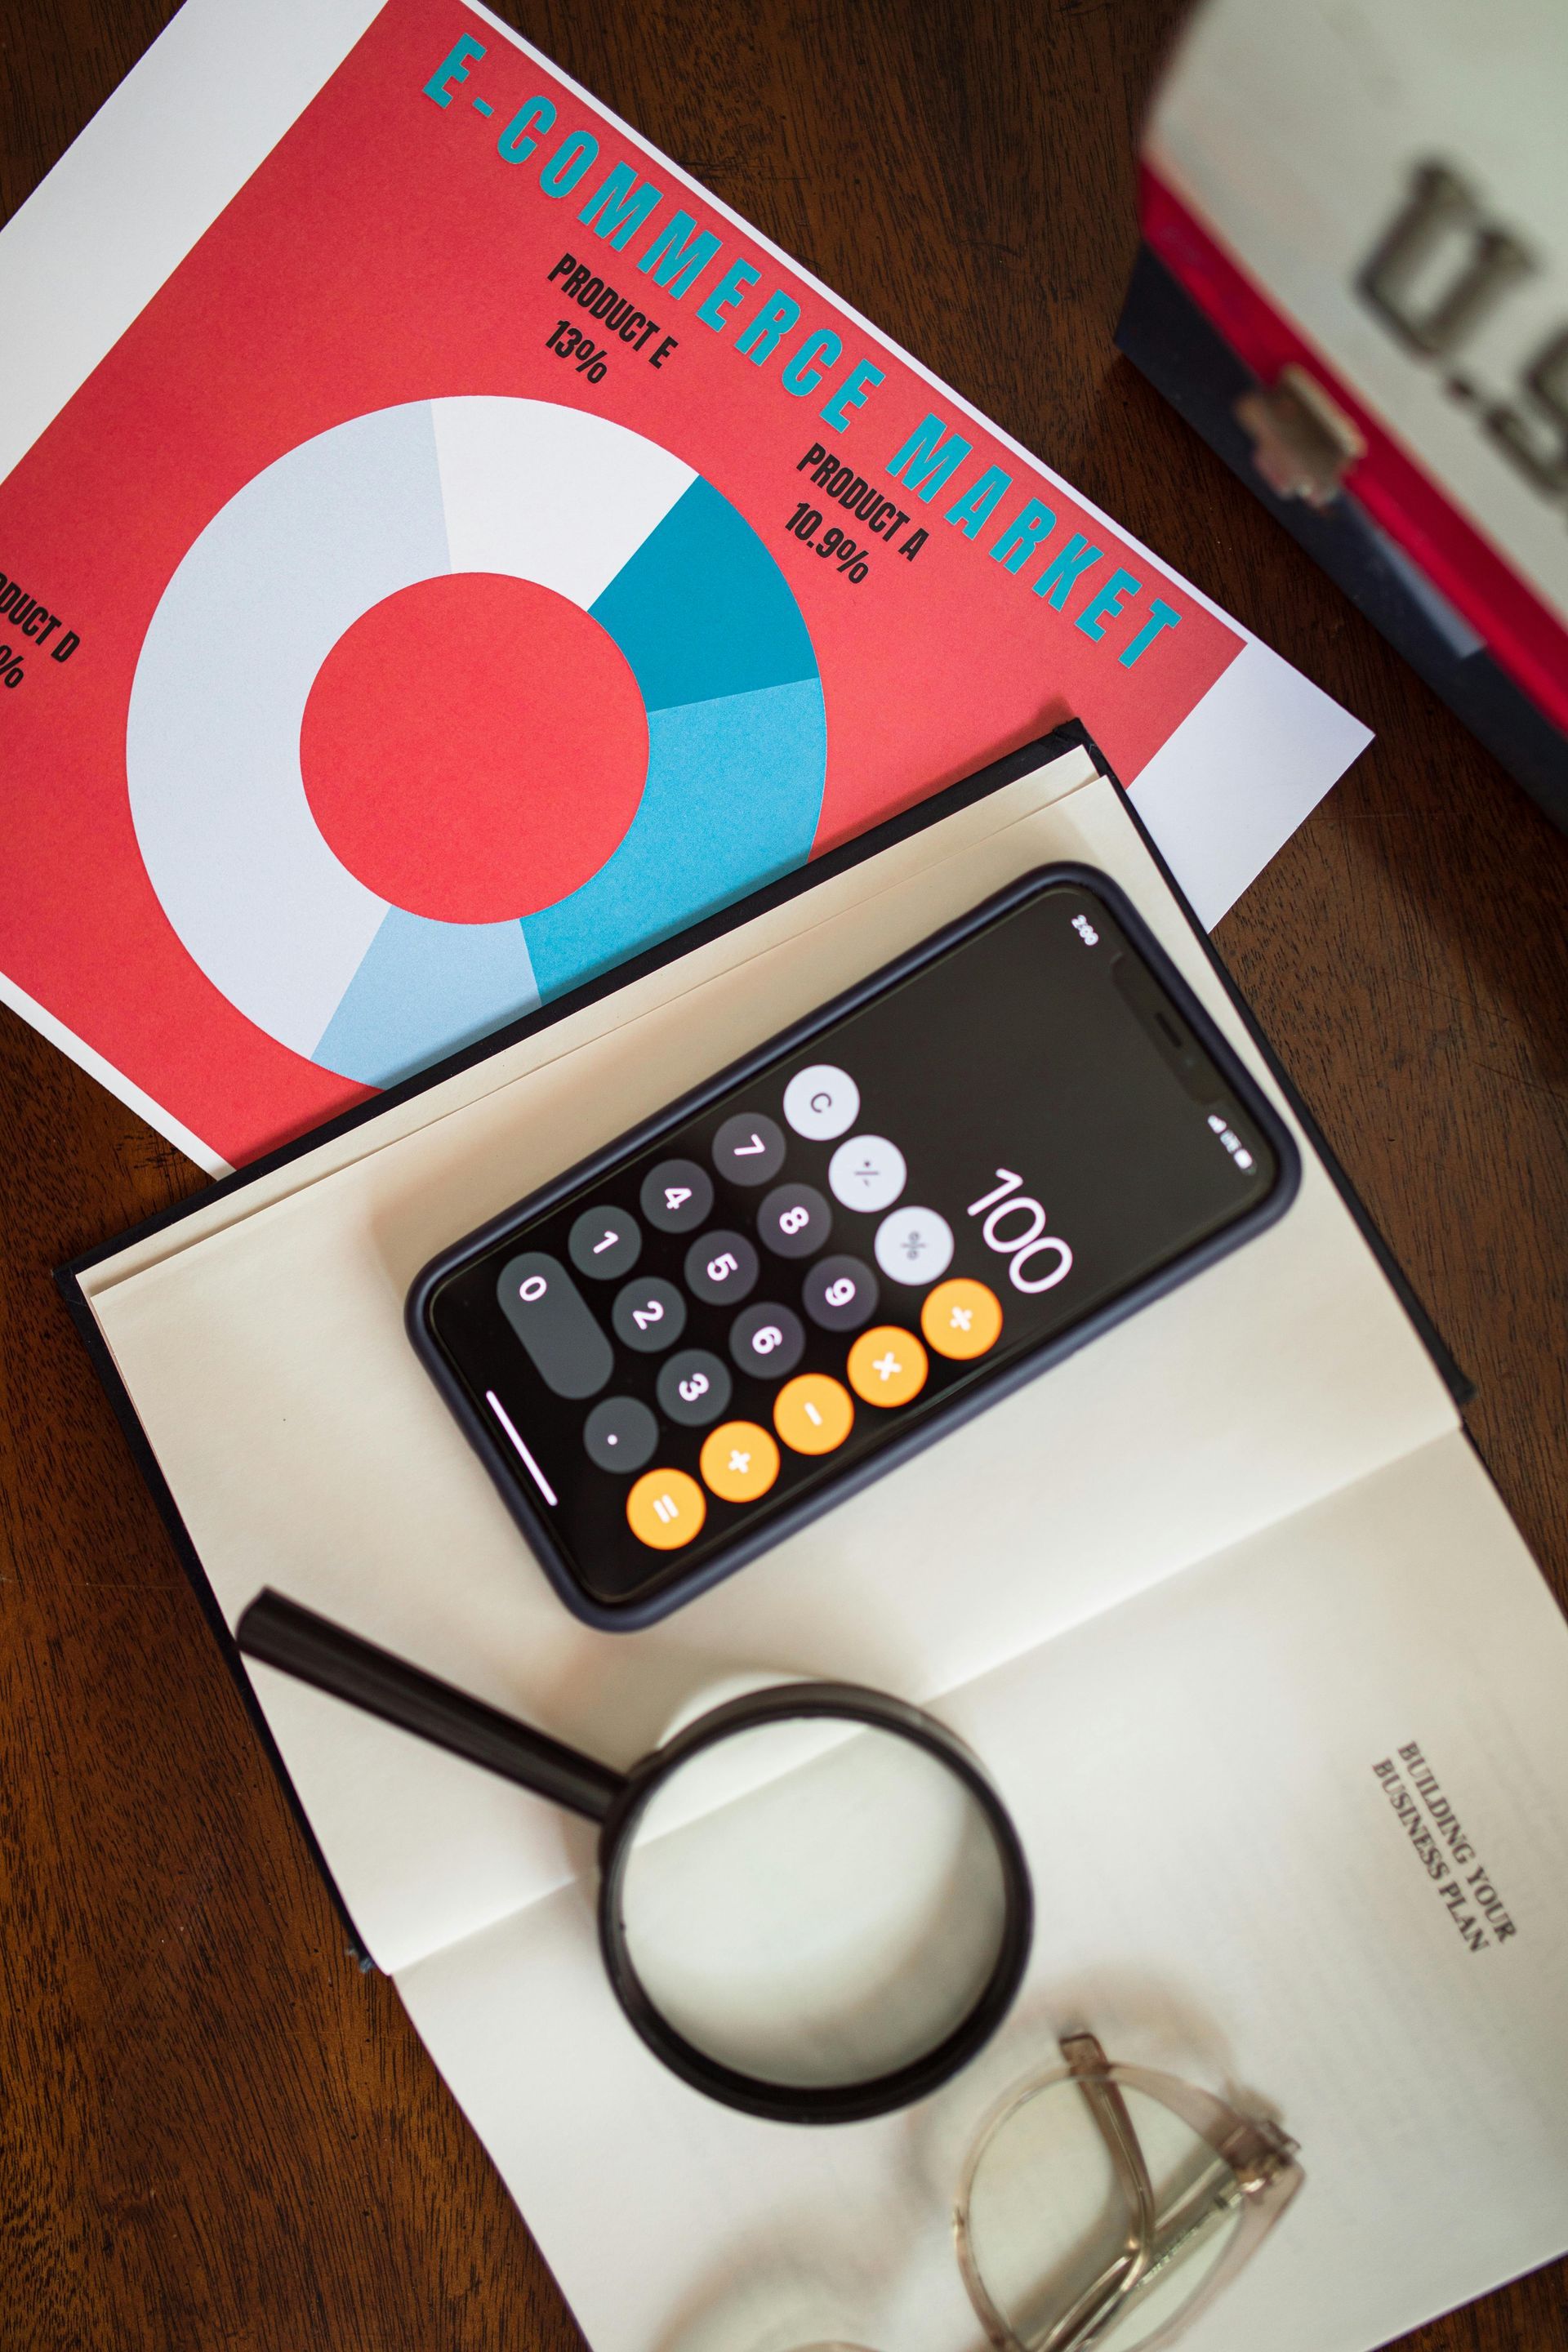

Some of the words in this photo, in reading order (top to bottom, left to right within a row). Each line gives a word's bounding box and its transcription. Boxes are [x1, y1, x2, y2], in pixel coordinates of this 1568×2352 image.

[423, 33, 885, 434] E-COMMERCE
[886, 412, 1183, 669] MARKET
[545, 319, 608, 384] 13%
[546, 252, 661, 353] PRODUCT
[648, 336, 679, 369] E
[784, 502, 869, 584] 10.9%
[796, 442, 911, 542] PRODUCT
[898, 528, 929, 562] A
[51, 630, 81, 663] D
[810, 1092, 833, 1114] C
[663, 1186, 693, 1210] 4
[706, 1252, 738, 1282] 5
[751, 1325, 783, 1355] 6
[733, 1133, 766, 1156] 7
[778, 1205, 810, 1236] 8
[824, 1277, 856, 1307] 9
[967, 1168, 1073, 1294] 100
[519, 1275, 548, 1303] 0
[592, 1230, 619, 1254] 1
[631, 1299, 665, 1331] 2
[678, 1372, 710, 1402] 3
[1372, 1758, 1450, 1880] BUSINESS
[1438, 1882, 1490, 1953] PLAN
[1397, 1740, 1476, 1864] BUILDING
[1466, 1864, 1517, 1944] YOUR
